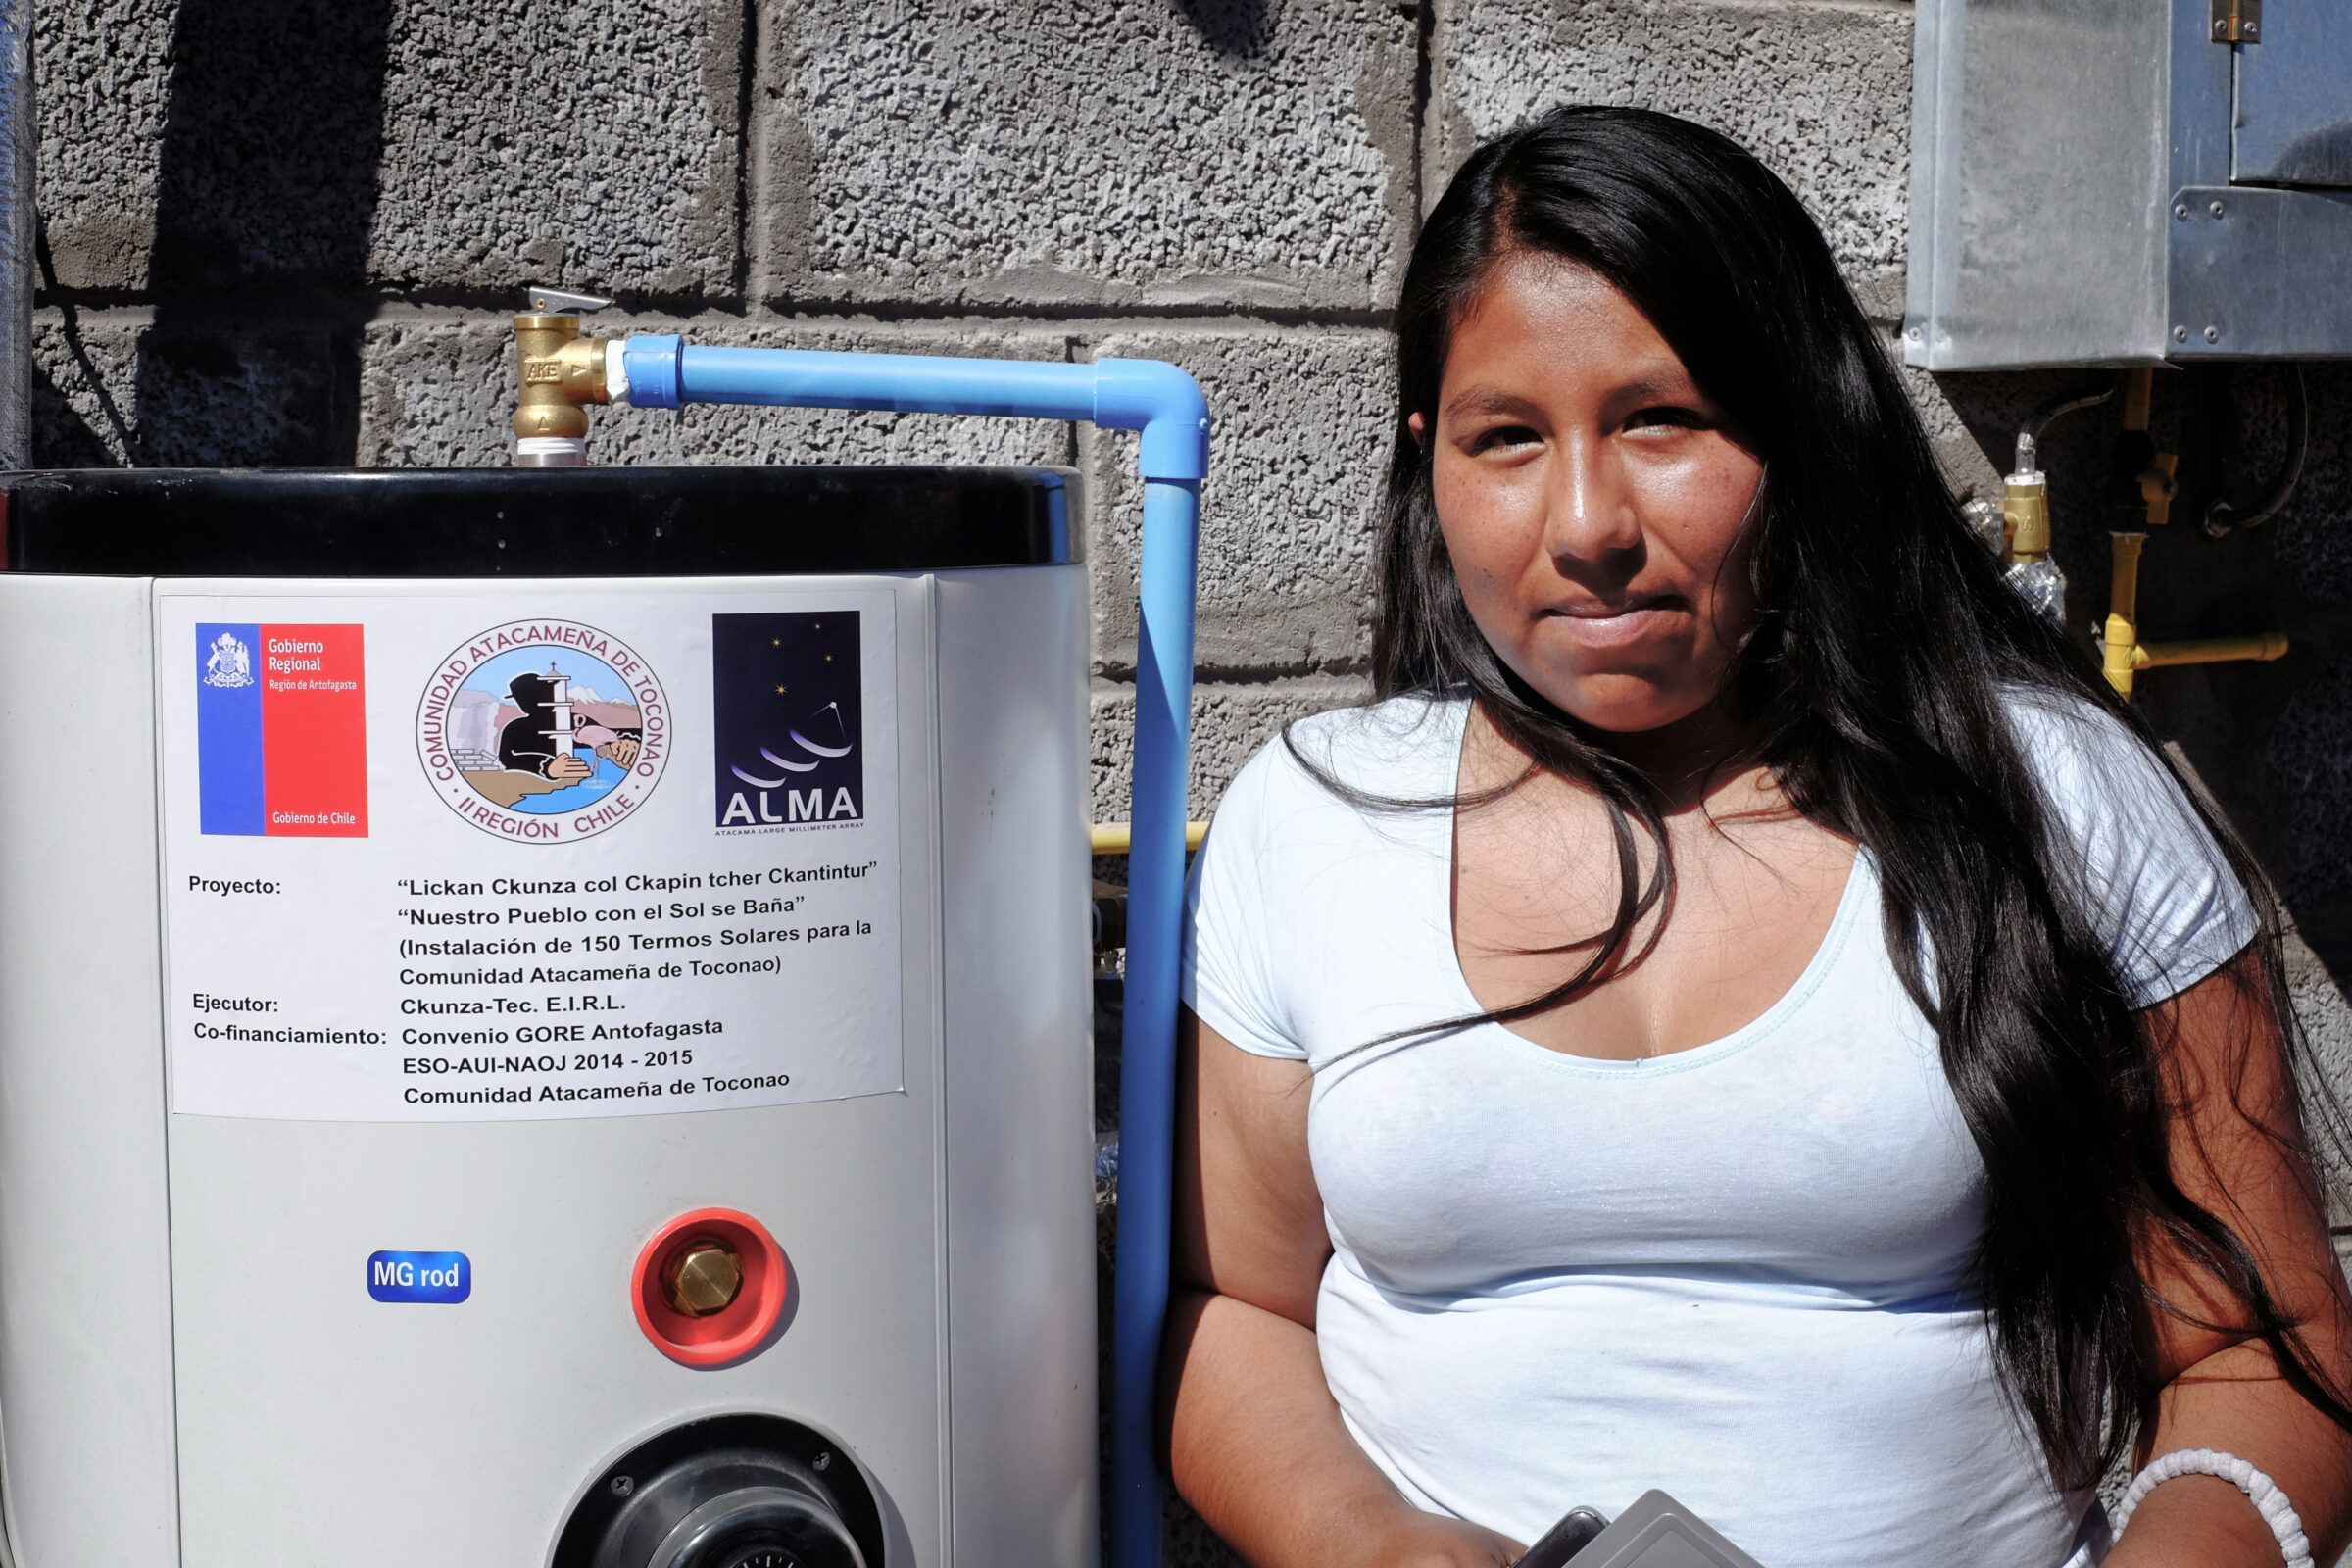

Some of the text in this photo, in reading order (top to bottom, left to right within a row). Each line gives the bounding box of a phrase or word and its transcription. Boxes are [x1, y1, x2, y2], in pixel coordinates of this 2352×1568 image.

[269, 638, 324, 654] Gobierno
[270, 656, 321, 674] Regional
[270, 679, 358, 692] Región de Antofagasta
[423, 625, 665, 781] COMUNIDAD ATACAMEÑA DE TOCONAO
[272, 811, 356, 825] Gobierno de Chile
[457, 794, 635, 838] II REGIÓN CHILE
[721, 786, 858, 825] ALMA
[714, 828, 757, 837] ATACAMA
[788, 824, 837, 833] MILLIMETER
[839, 821, 864, 830] ARRAY
[189, 875, 281, 898] Proyecto:
[397, 879, 484, 896] “Lickan
[491, 878, 577, 895] Ckunza
[584, 875, 617, 893] col
[625, 872, 702, 894] Ckapin
[709, 870, 762, 887] tcher
[398, 908, 500, 926] “Nuestro
[508, 907, 588, 924] Pueblo
[595, 908, 636, 922] con
[643, 904, 662, 920] el
[669, 902, 705, 919] Sol
[711, 905, 736, 917] se
[399, 919, 872, 959] (Instalación de 150 Termos Solares para la
[399, 956, 782, 986] Comunidad Atacameña de Toconao)
[193, 993, 278, 1014] Ejecutor:
[401, 994, 626, 1015] Ckunza-Tec. E.I.R.L.
[194, 1022, 387, 1045] Co-financiamiento:
[402, 1019, 723, 1045] Convenio GORE Antofagasta
[403, 1054, 566, 1075] ESO-AUI-NAOJ
[574, 1053, 624, 1071] 2014
[644, 1049, 693, 1067] 2015
[403, 1074, 790, 1104] Comunidad Atacameña de Toconao
[374, 1261, 459, 1287] MG rod
